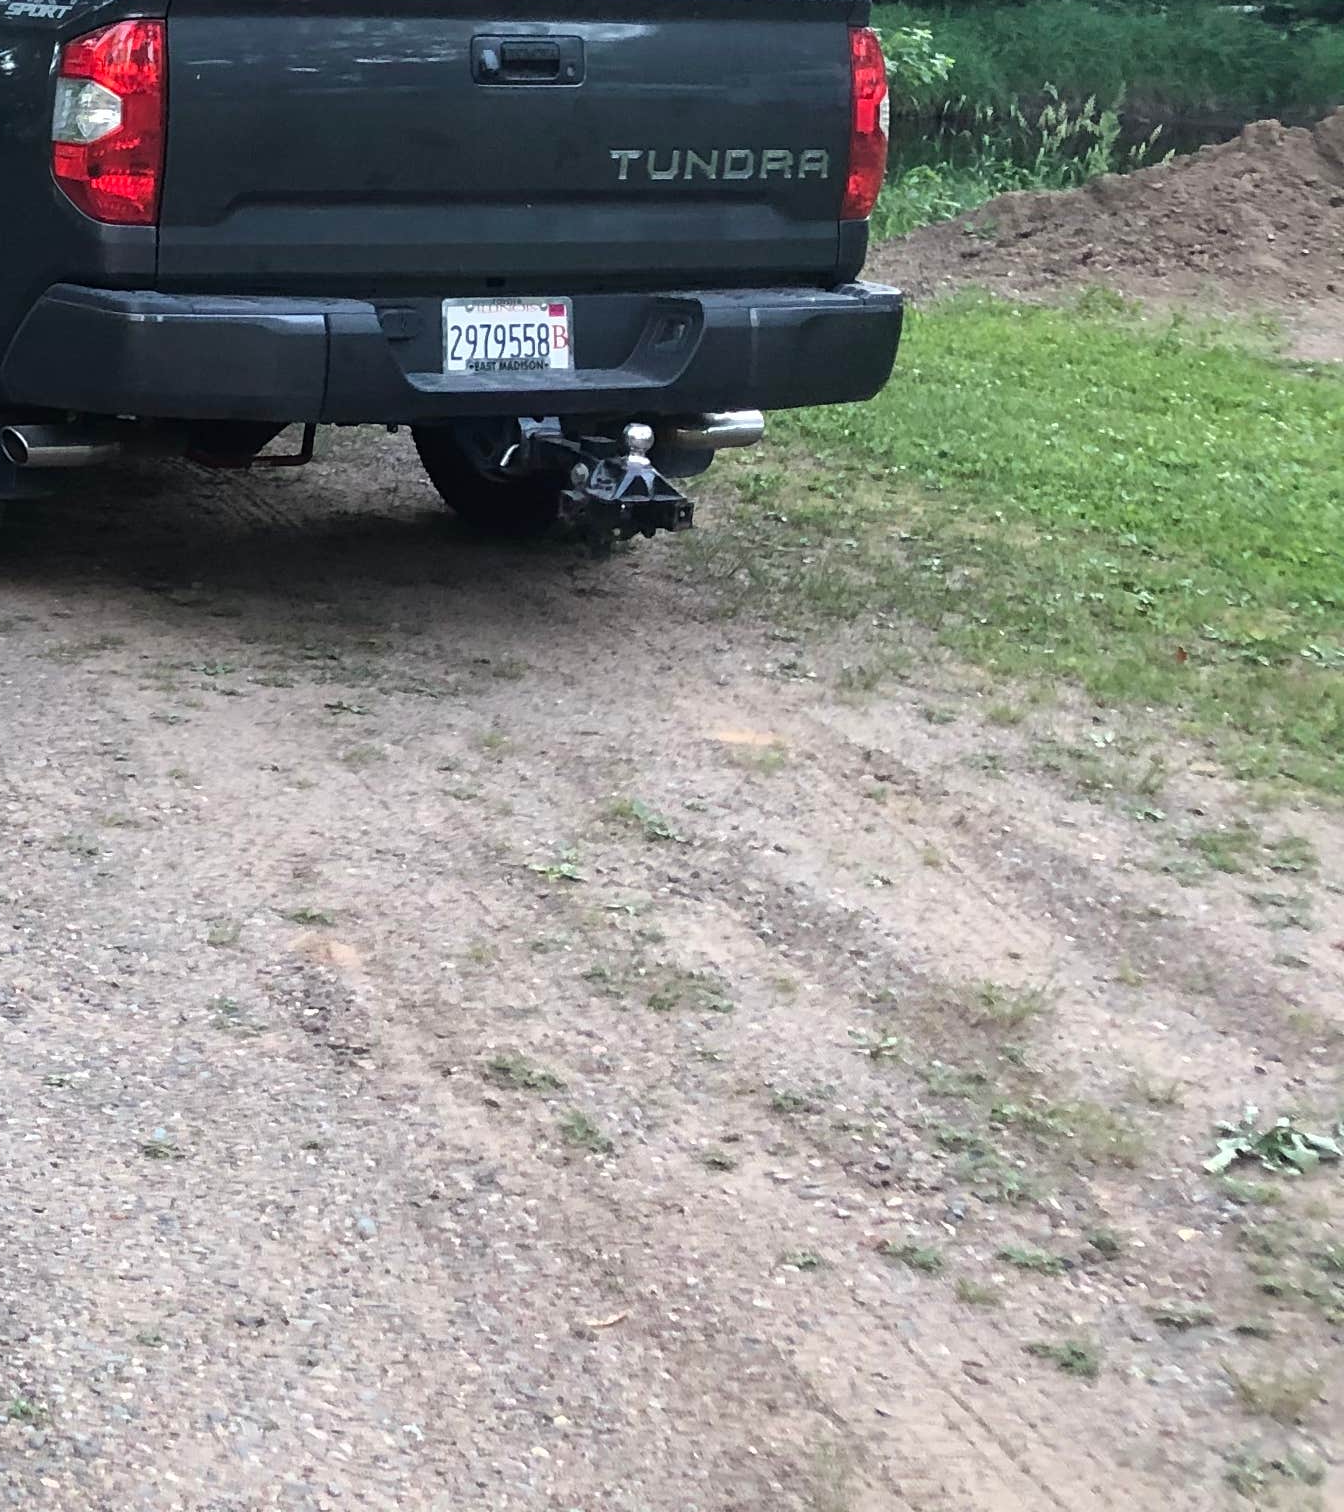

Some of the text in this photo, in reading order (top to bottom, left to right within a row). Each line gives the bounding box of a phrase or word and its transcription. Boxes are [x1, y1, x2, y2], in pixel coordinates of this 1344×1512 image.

[5, 2, 73, 19] SPORT
[609, 149, 830, 180] TUNDRA
[450, 323, 570, 361] 2979558 B
[474, 359, 544, 371] EAST MADISON
